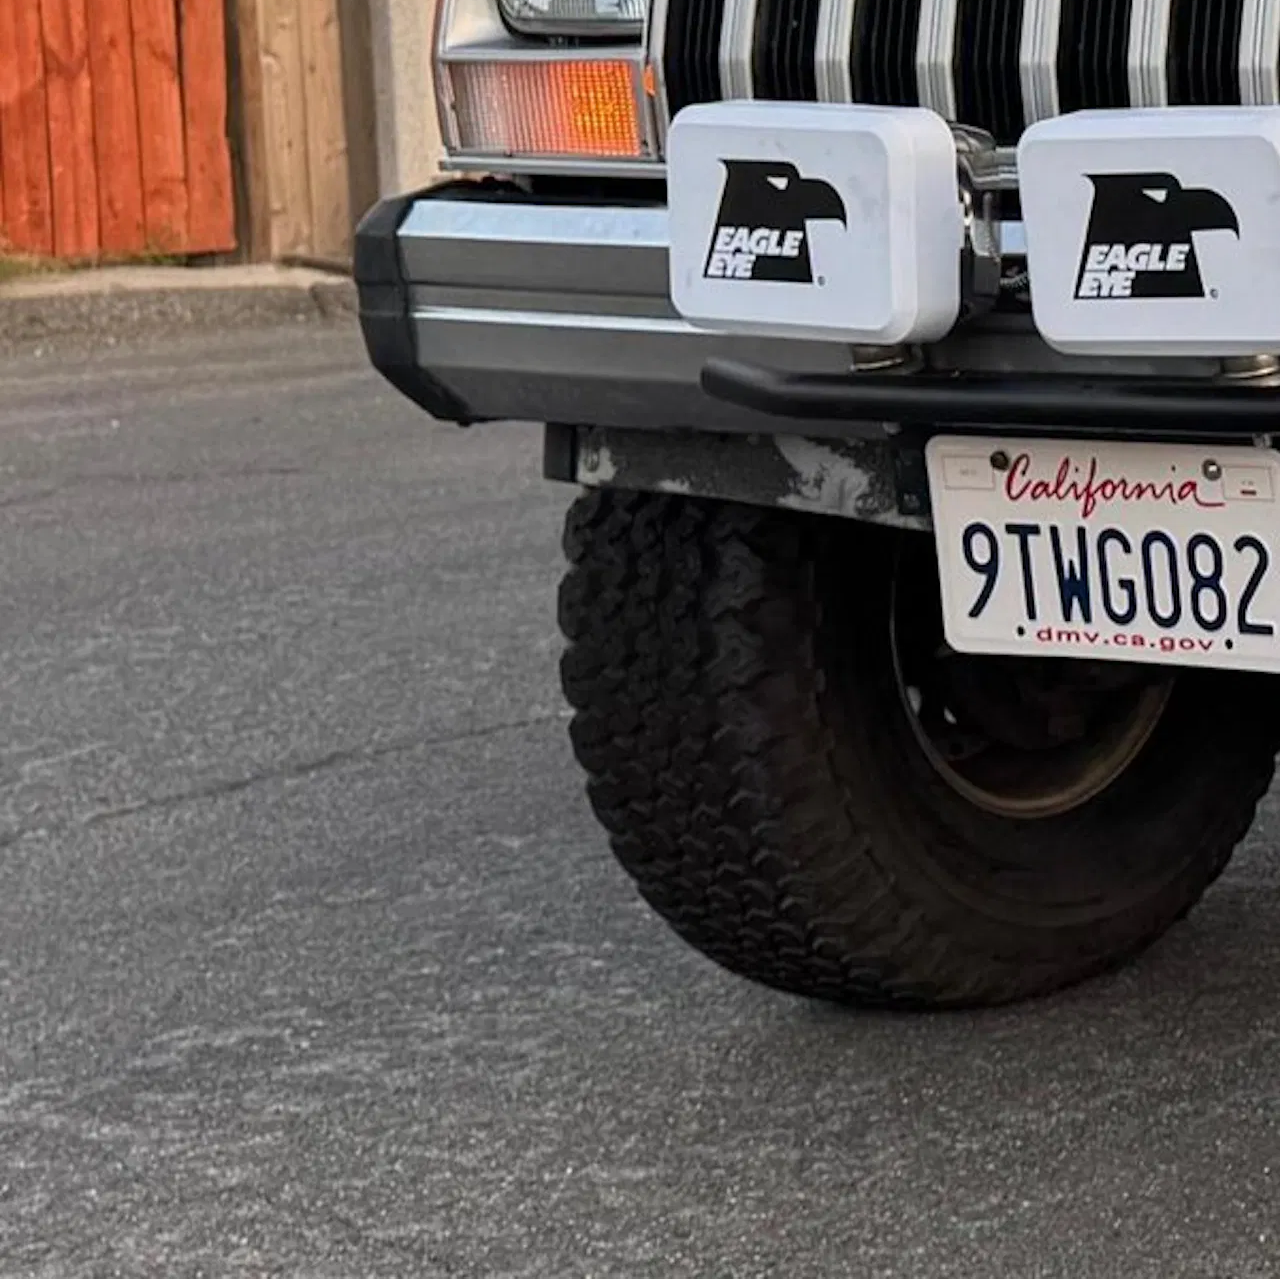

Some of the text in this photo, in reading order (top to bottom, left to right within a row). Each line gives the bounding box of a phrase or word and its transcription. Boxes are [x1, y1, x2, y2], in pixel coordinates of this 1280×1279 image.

[716, 226, 804, 259] EAGLE
[706, 252, 754, 280] EYE
[1087, 243, 1190, 272] EAGLE
[1078, 270, 1134, 298] EYE
[1005, 453, 1226, 518] California
[962, 521, 1275, 637] 9TWG082
[1036, 627, 1214, 653] dmv.ca.gov
